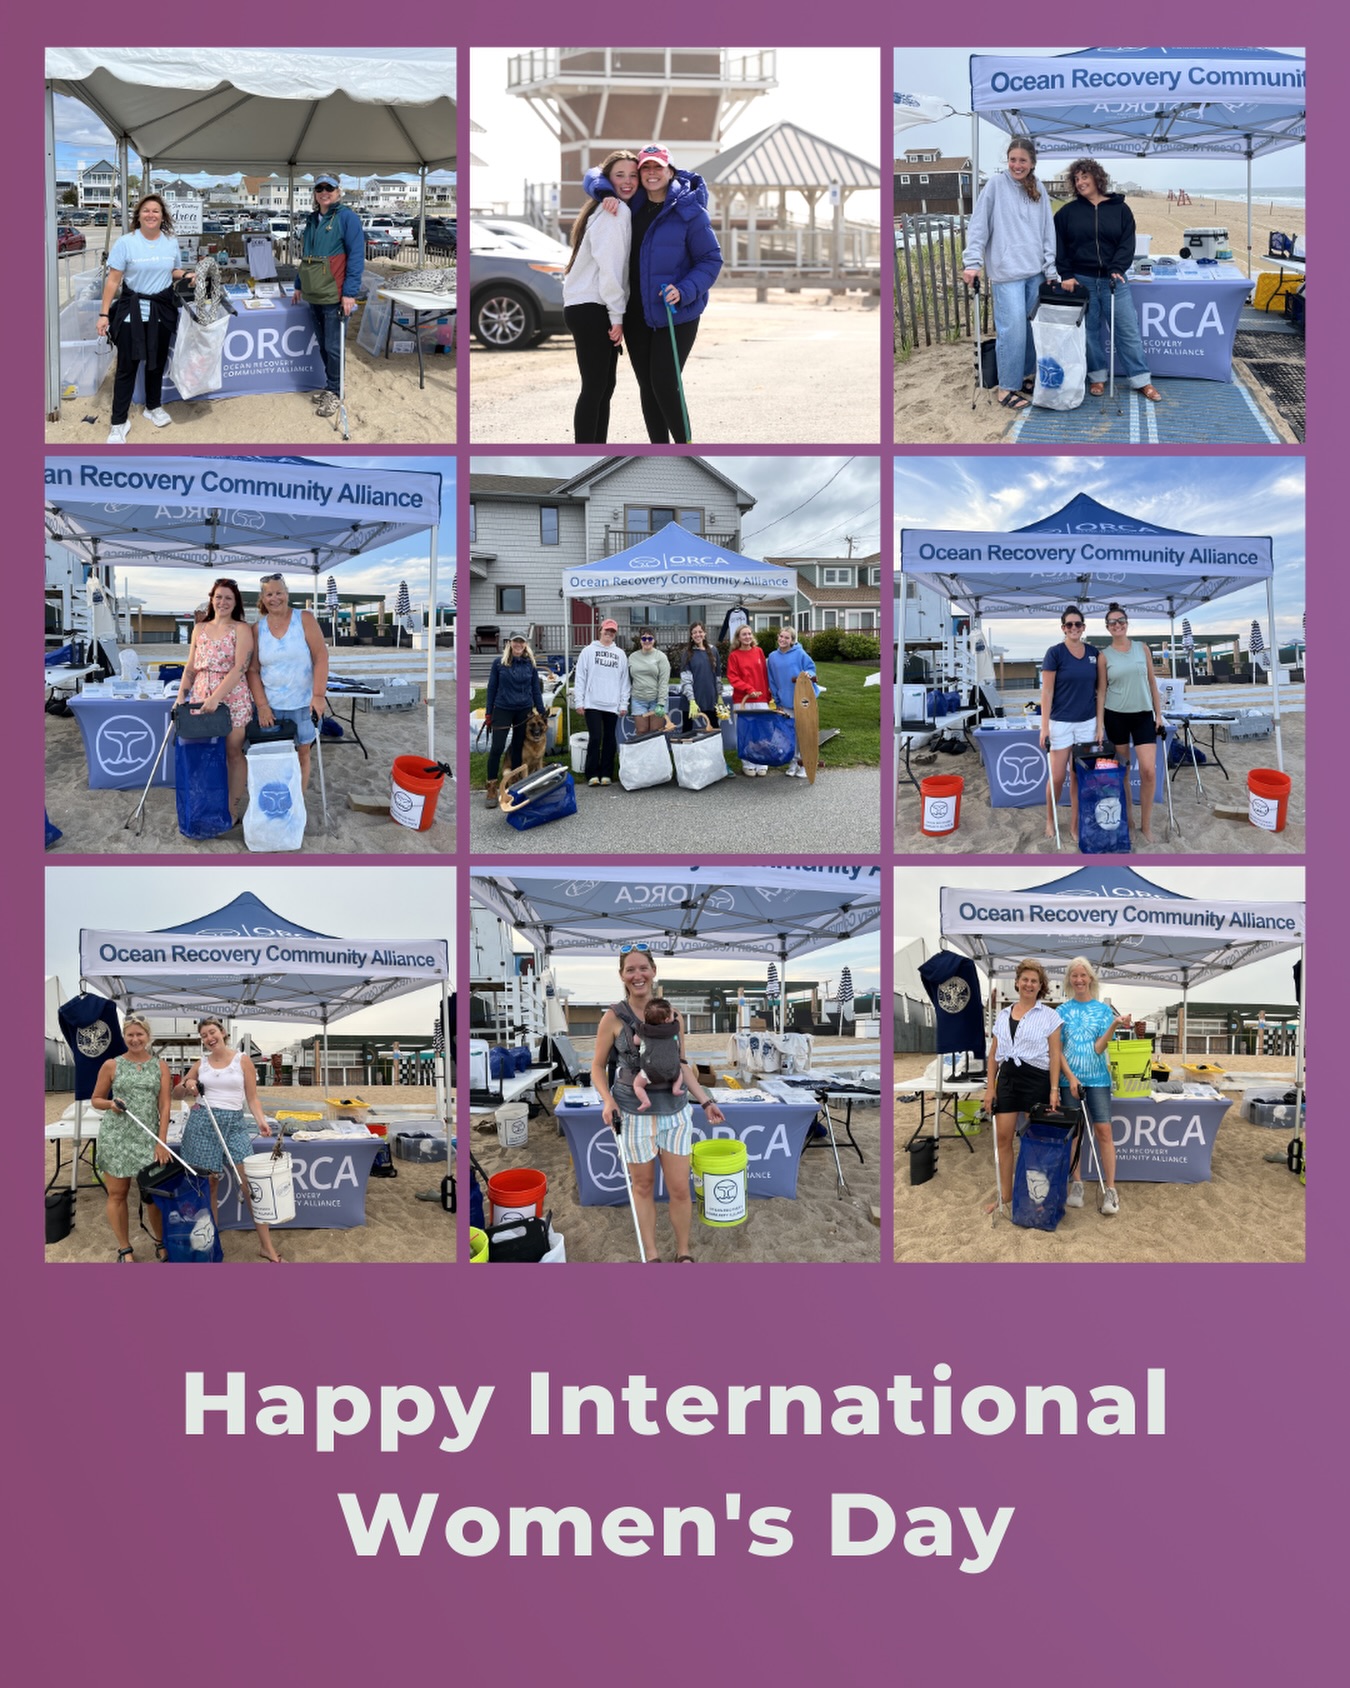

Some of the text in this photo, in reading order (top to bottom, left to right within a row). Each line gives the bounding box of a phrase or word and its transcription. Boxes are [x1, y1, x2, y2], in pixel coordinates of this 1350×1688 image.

[991, 66, 1306, 93] Ocean Recovery Communit
[1142, 301, 1225, 338] RCA
[223, 325, 320, 362] ORCA
[1141, 340, 1183, 348] ECOVERY
[223, 360, 294, 371] OCEAN RECOVERY
[223, 365, 314, 377] COMMUNITY ALLIANCE
[80, 470, 195, 496] Recovery
[201, 470, 332, 506] Community
[337, 483, 424, 508] Alliance
[1075, 522, 1158, 534] ORCA
[670, 555, 730, 565] ORCA
[918, 543, 1258, 567] Ocean Recovery Community Alliance
[570, 573, 789, 588] Ocean Recovery Community Alliance
[959, 901, 1296, 930] Ocean Recovery Community Alliance
[99, 943, 435, 968] Ocean Recovery Community Alliance
[1152, 1155, 1188, 1164] ALLIANCE
[291, 1155, 359, 1190] RCA
[303, 1199, 341, 1207] ALLIANCE
